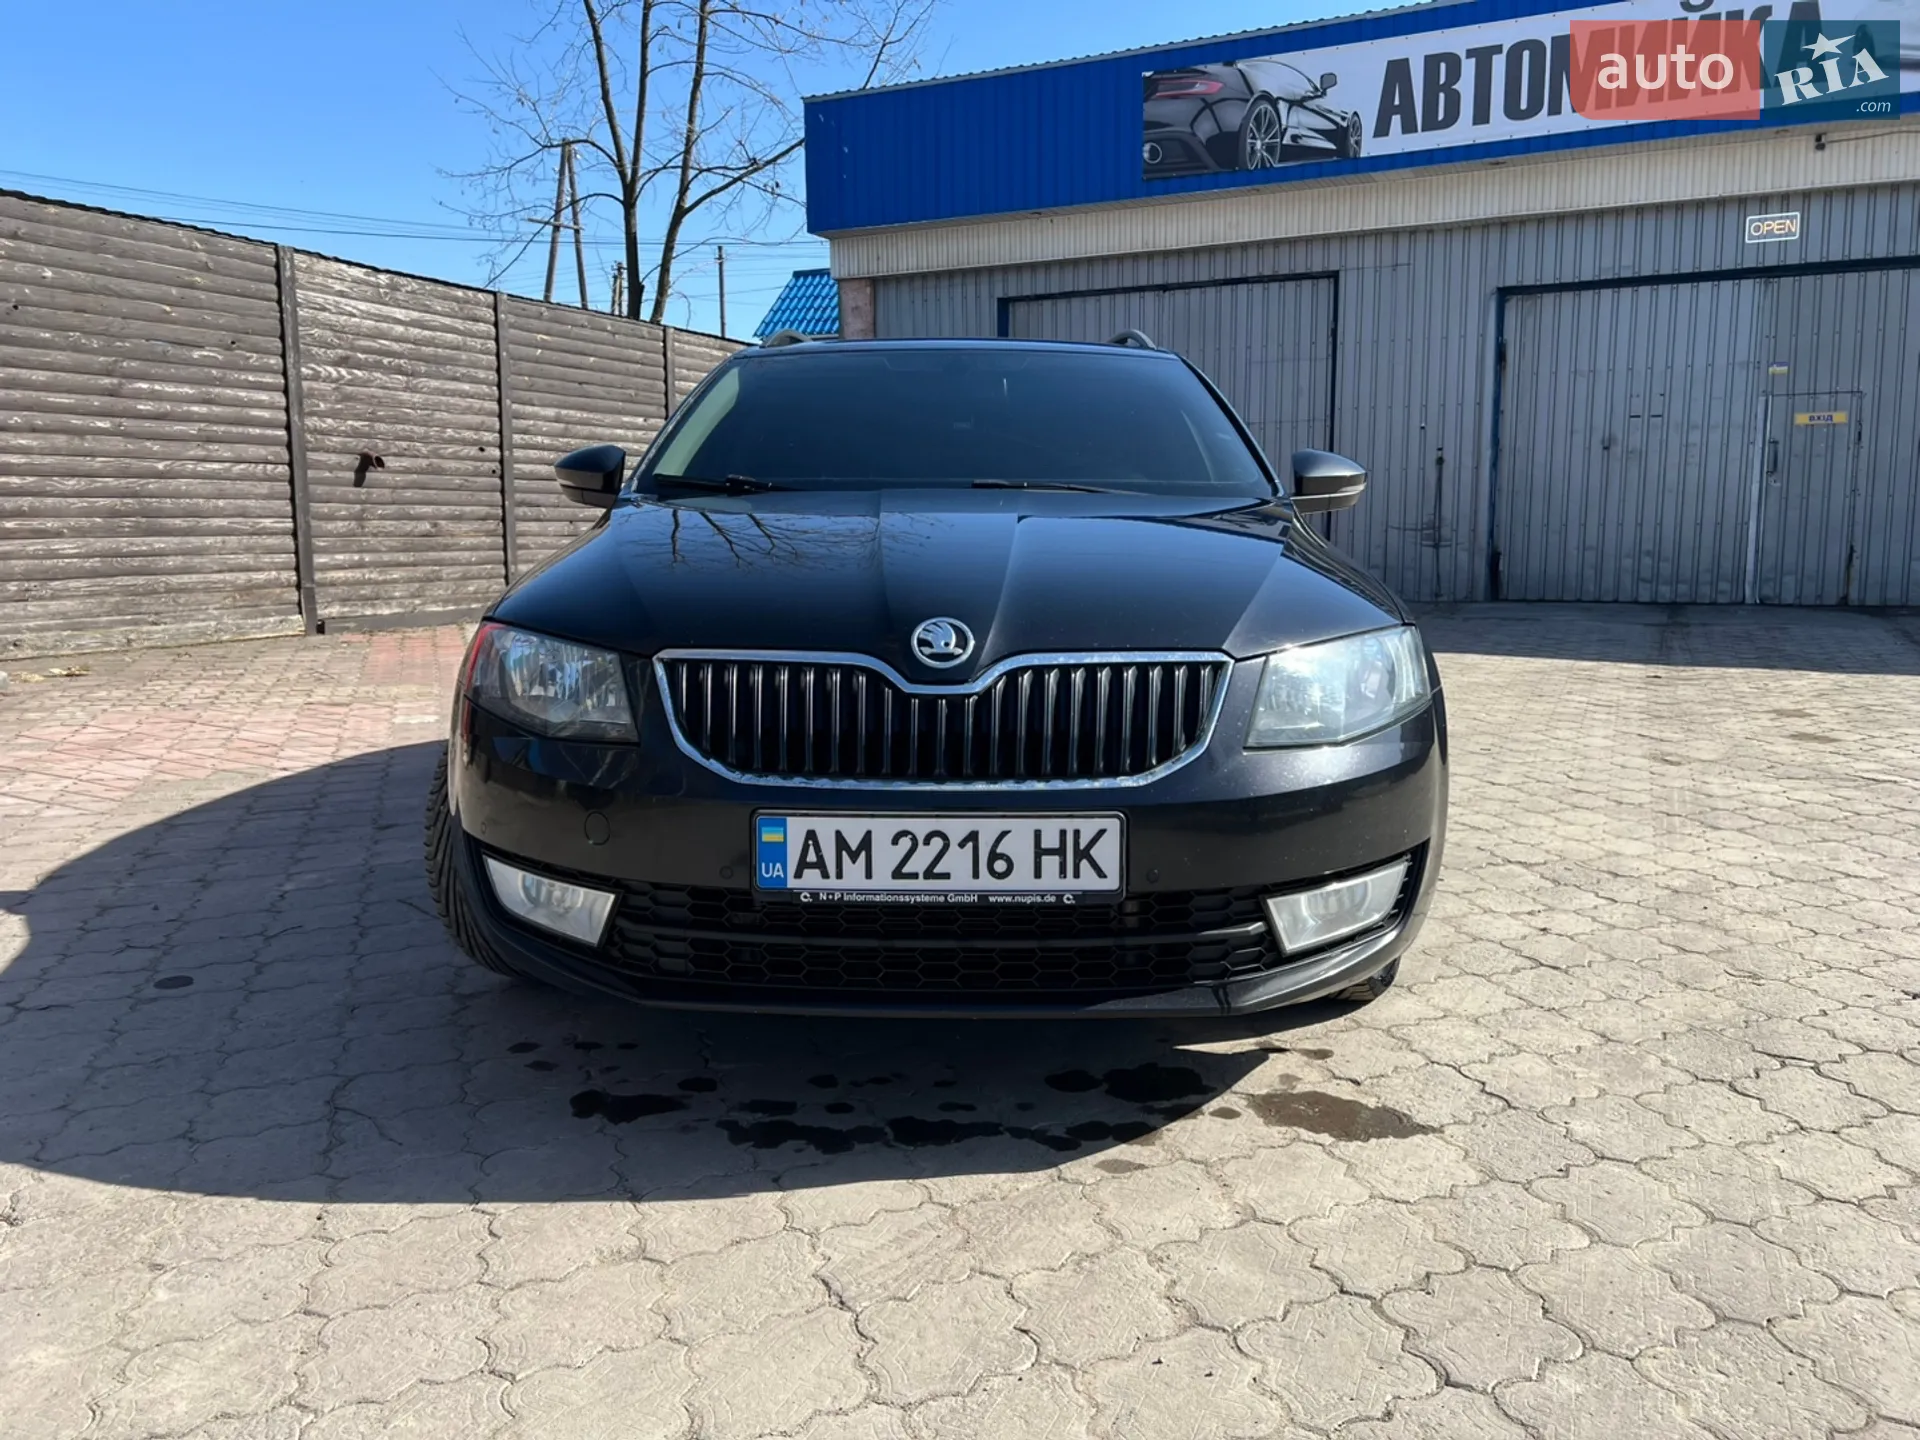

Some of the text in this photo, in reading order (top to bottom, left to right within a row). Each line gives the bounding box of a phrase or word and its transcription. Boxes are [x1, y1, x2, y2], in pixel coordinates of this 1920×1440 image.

[1751, 219, 1796, 236] OPEN
[793, 828, 1108, 880] AM 2216 HK
[761, 863, 784, 878] UA
[844, 893, 945, 904] Informationssysteme
[947, 893, 978, 902] GmbH
[988, 894, 1056, 904] www.nupis.de
